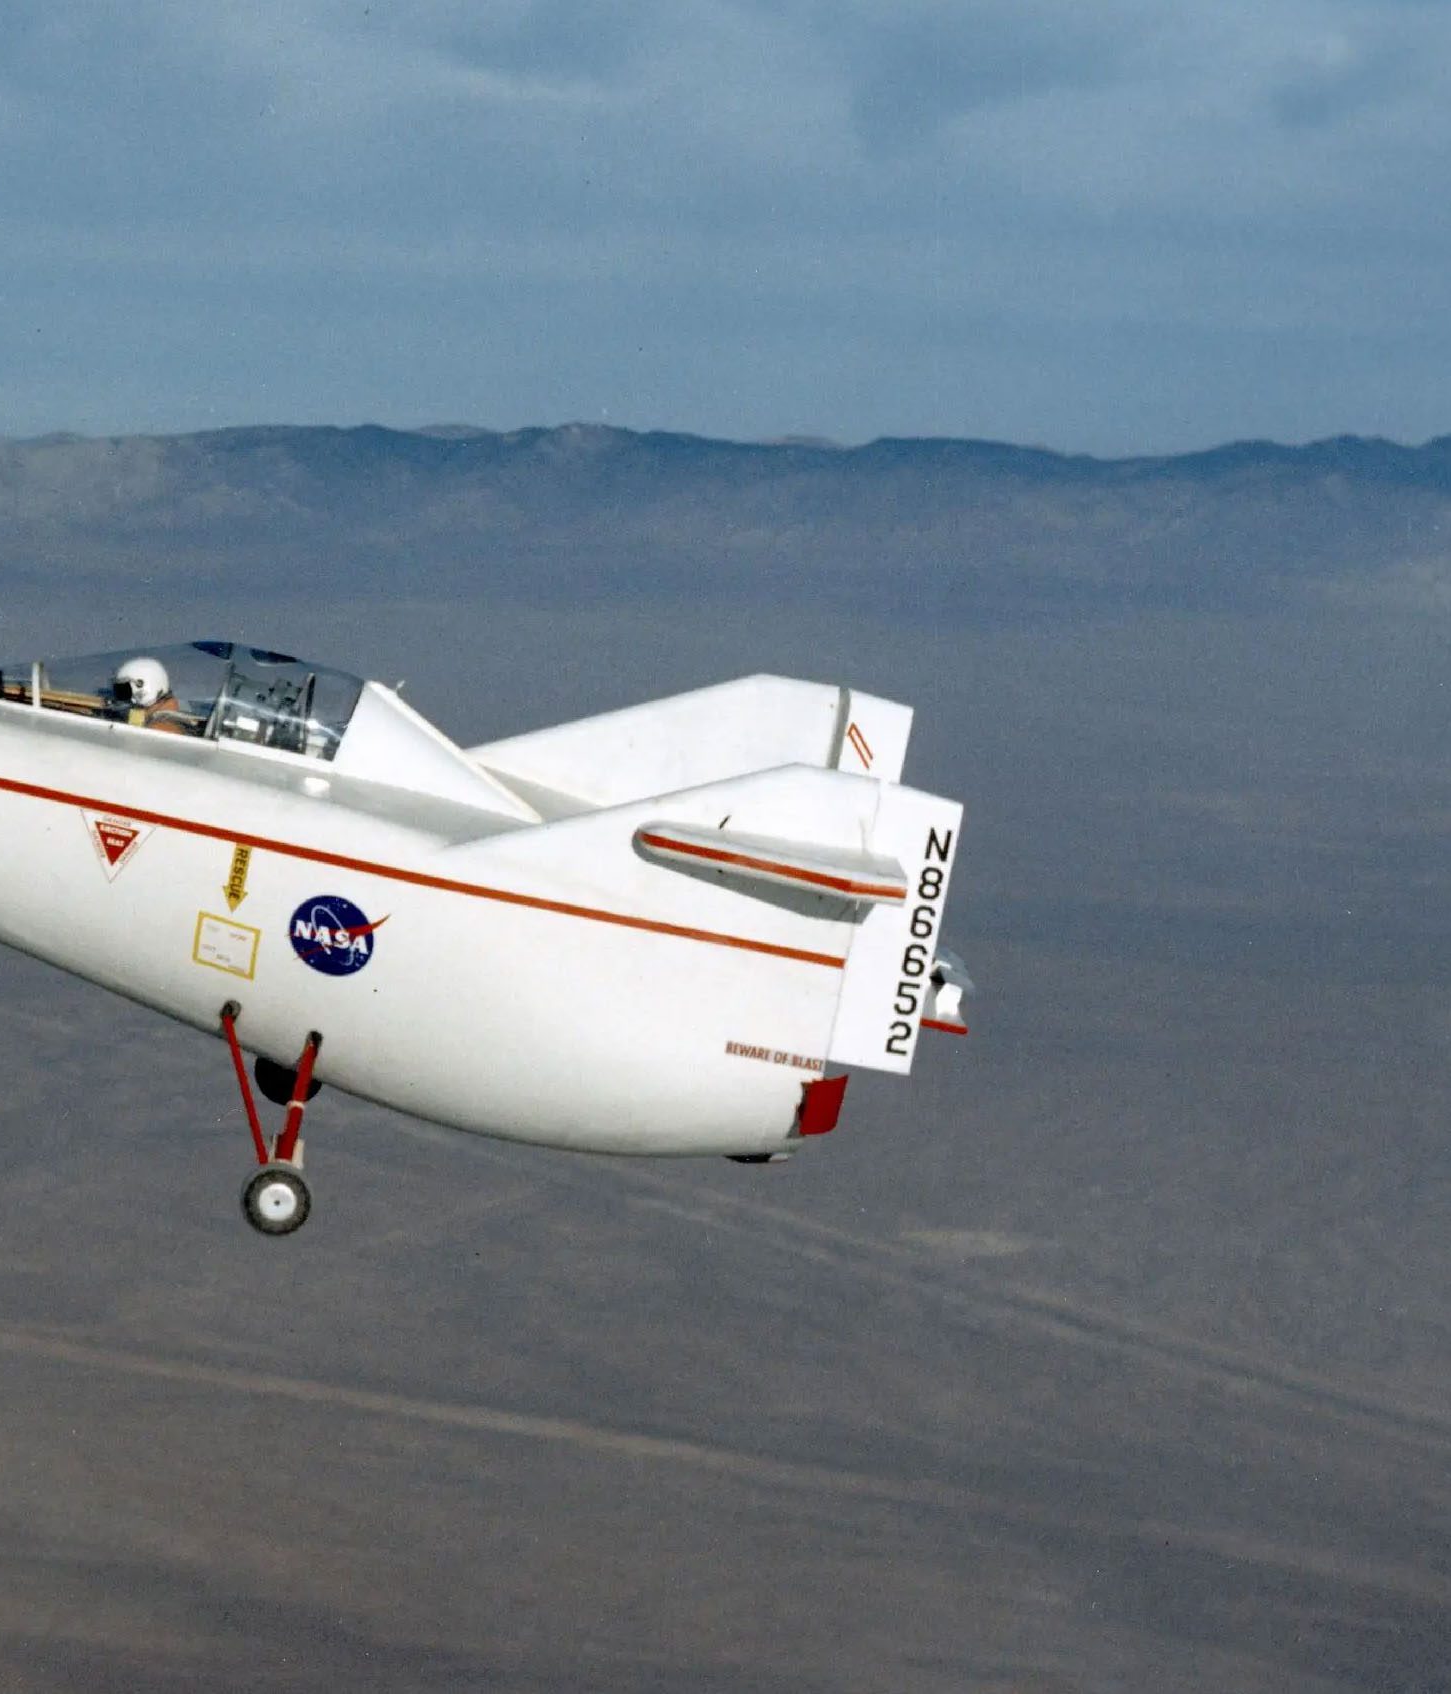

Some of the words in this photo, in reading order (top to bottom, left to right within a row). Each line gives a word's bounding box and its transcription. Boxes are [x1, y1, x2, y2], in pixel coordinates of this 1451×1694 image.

[228, 848, 248, 900] RESCUE
[294, 919, 369, 955] NASA
[885, 827, 952, 1056] N86652
[725, 1040, 770, 1061] BEWARE
[773, 1051, 789, 1065] OF
[791, 1054, 824, 1071] BLAST
